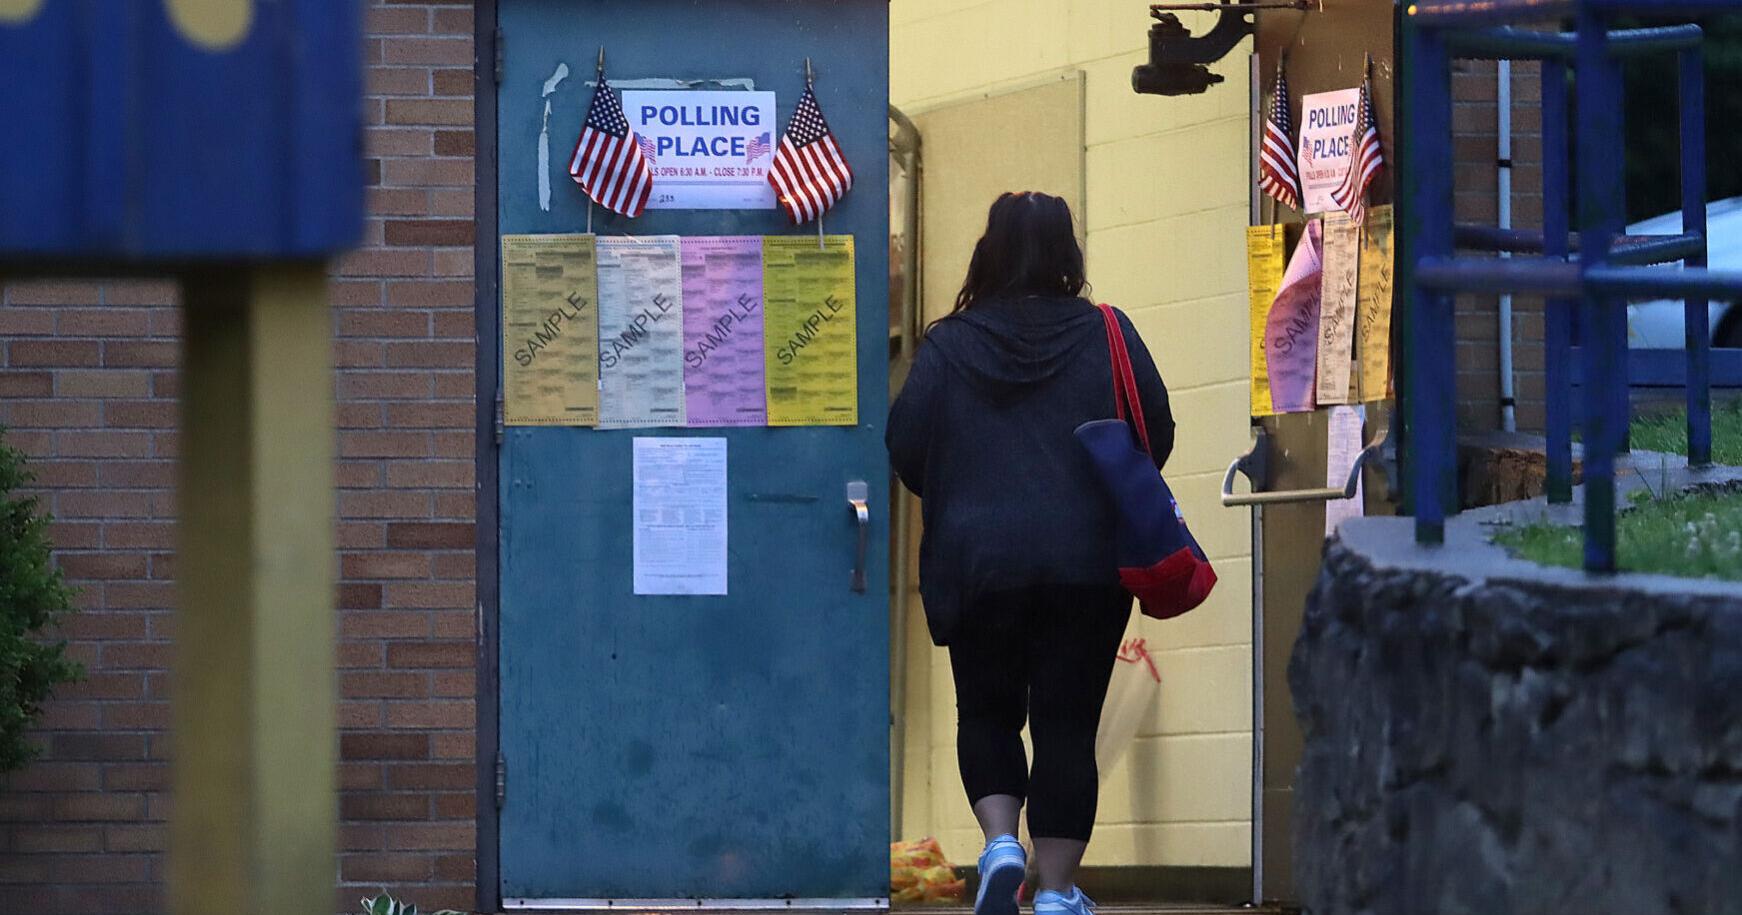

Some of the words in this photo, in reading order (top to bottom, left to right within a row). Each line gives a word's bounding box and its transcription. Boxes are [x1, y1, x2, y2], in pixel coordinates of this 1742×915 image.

[641, 105, 760, 126] POLLING
[1309, 103, 1356, 130] POLLING
[657, 136, 745, 156] PLACE
[1312, 135, 1350, 160] PLACE
[661, 167, 678, 177] OPEN
[680, 167, 693, 177] 6:30
[694, 167, 707, 177] A.M.
[714, 167, 735, 177] CLOSE
[751, 167, 764, 177] P.M.
[514, 291, 588, 367] SAMPLE
[599, 292, 673, 369] SAMPLE
[684, 292, 758, 369] SAMPLE
[776, 294, 844, 366] SAMPLE
[1274, 290, 1320, 355] SAMPL
